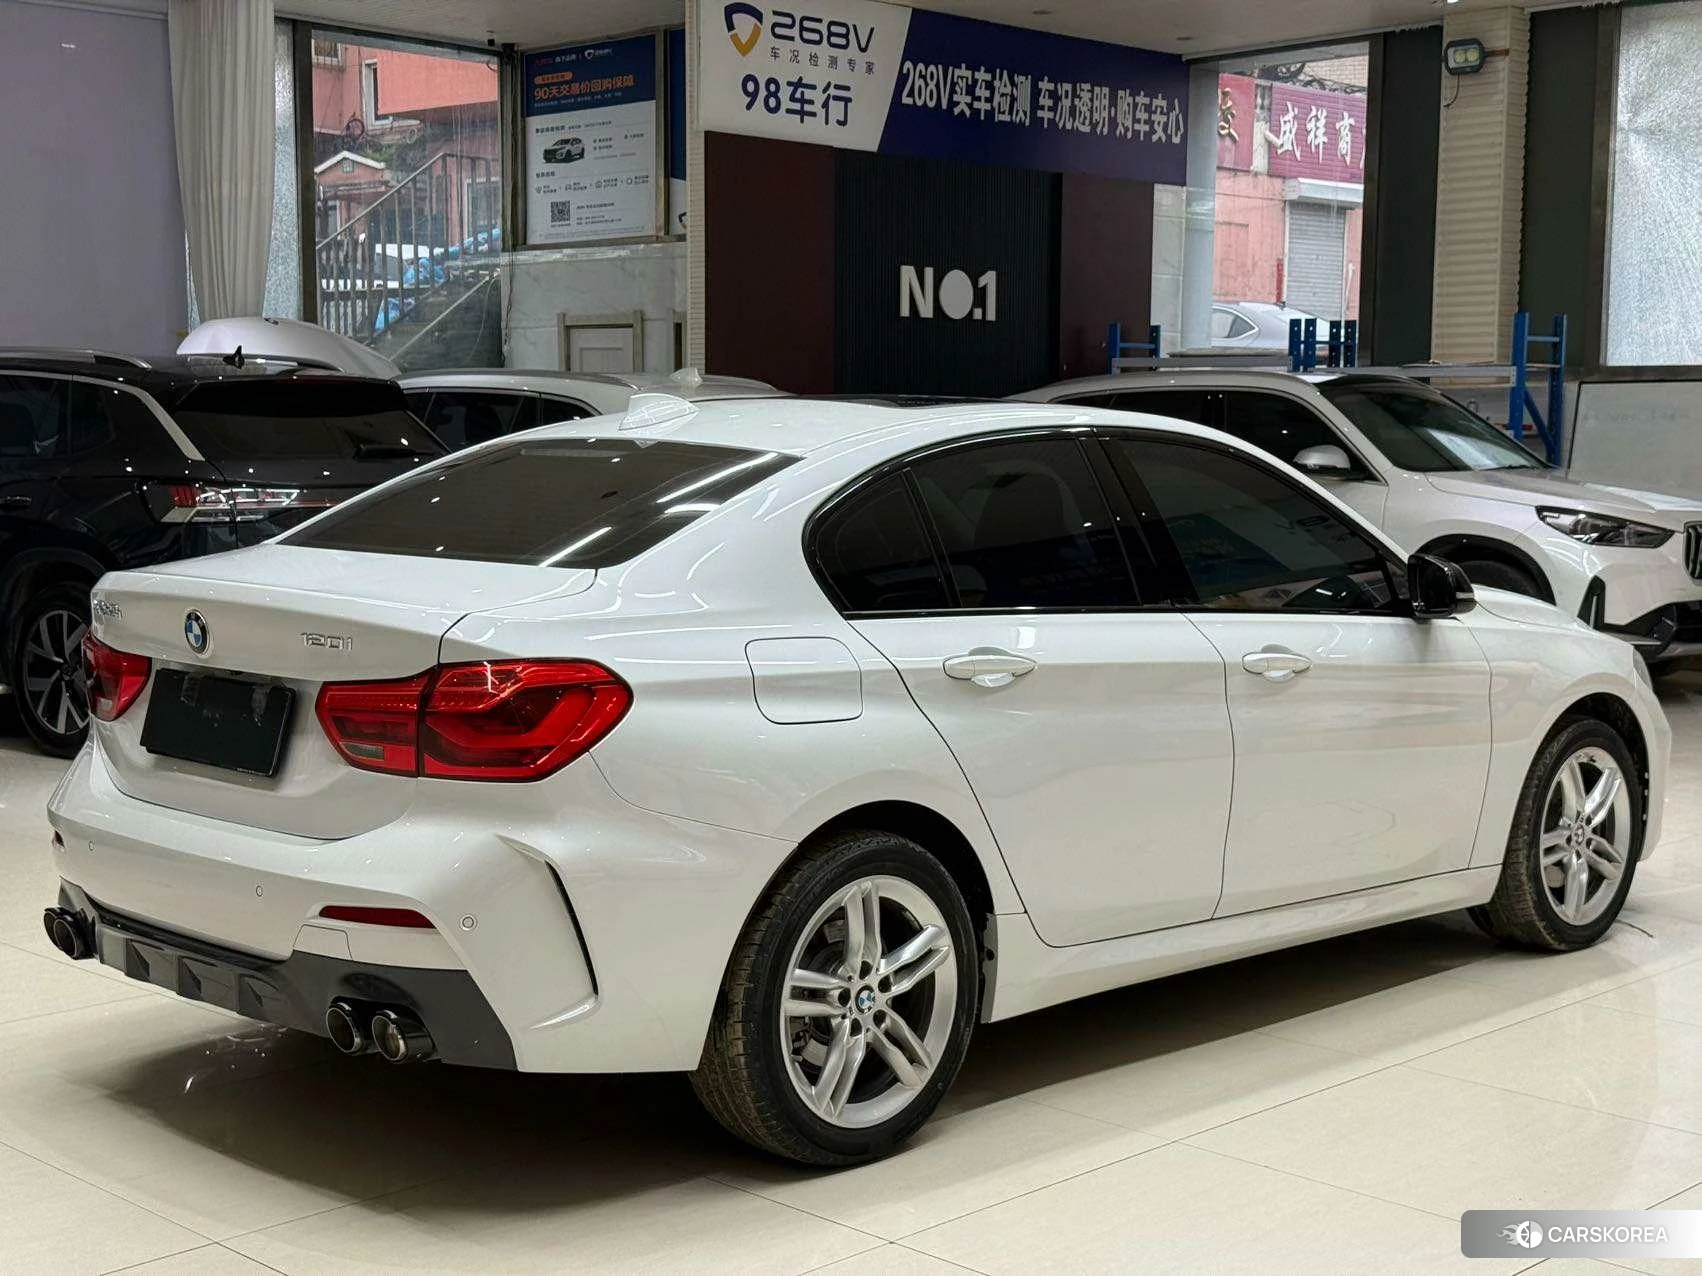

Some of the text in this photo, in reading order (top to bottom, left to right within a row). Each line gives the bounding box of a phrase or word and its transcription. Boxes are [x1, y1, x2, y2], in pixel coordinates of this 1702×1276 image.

[770, 9, 875, 53] 268V
[769, 46, 875, 76] 车况检测专家
[741, 73, 853, 127] 98车行
[901, 60, 1032, 127] 268V实车检测
[1037, 75, 1185, 144] 车况透明·购车安心
[899, 264, 997, 322] NO.1
